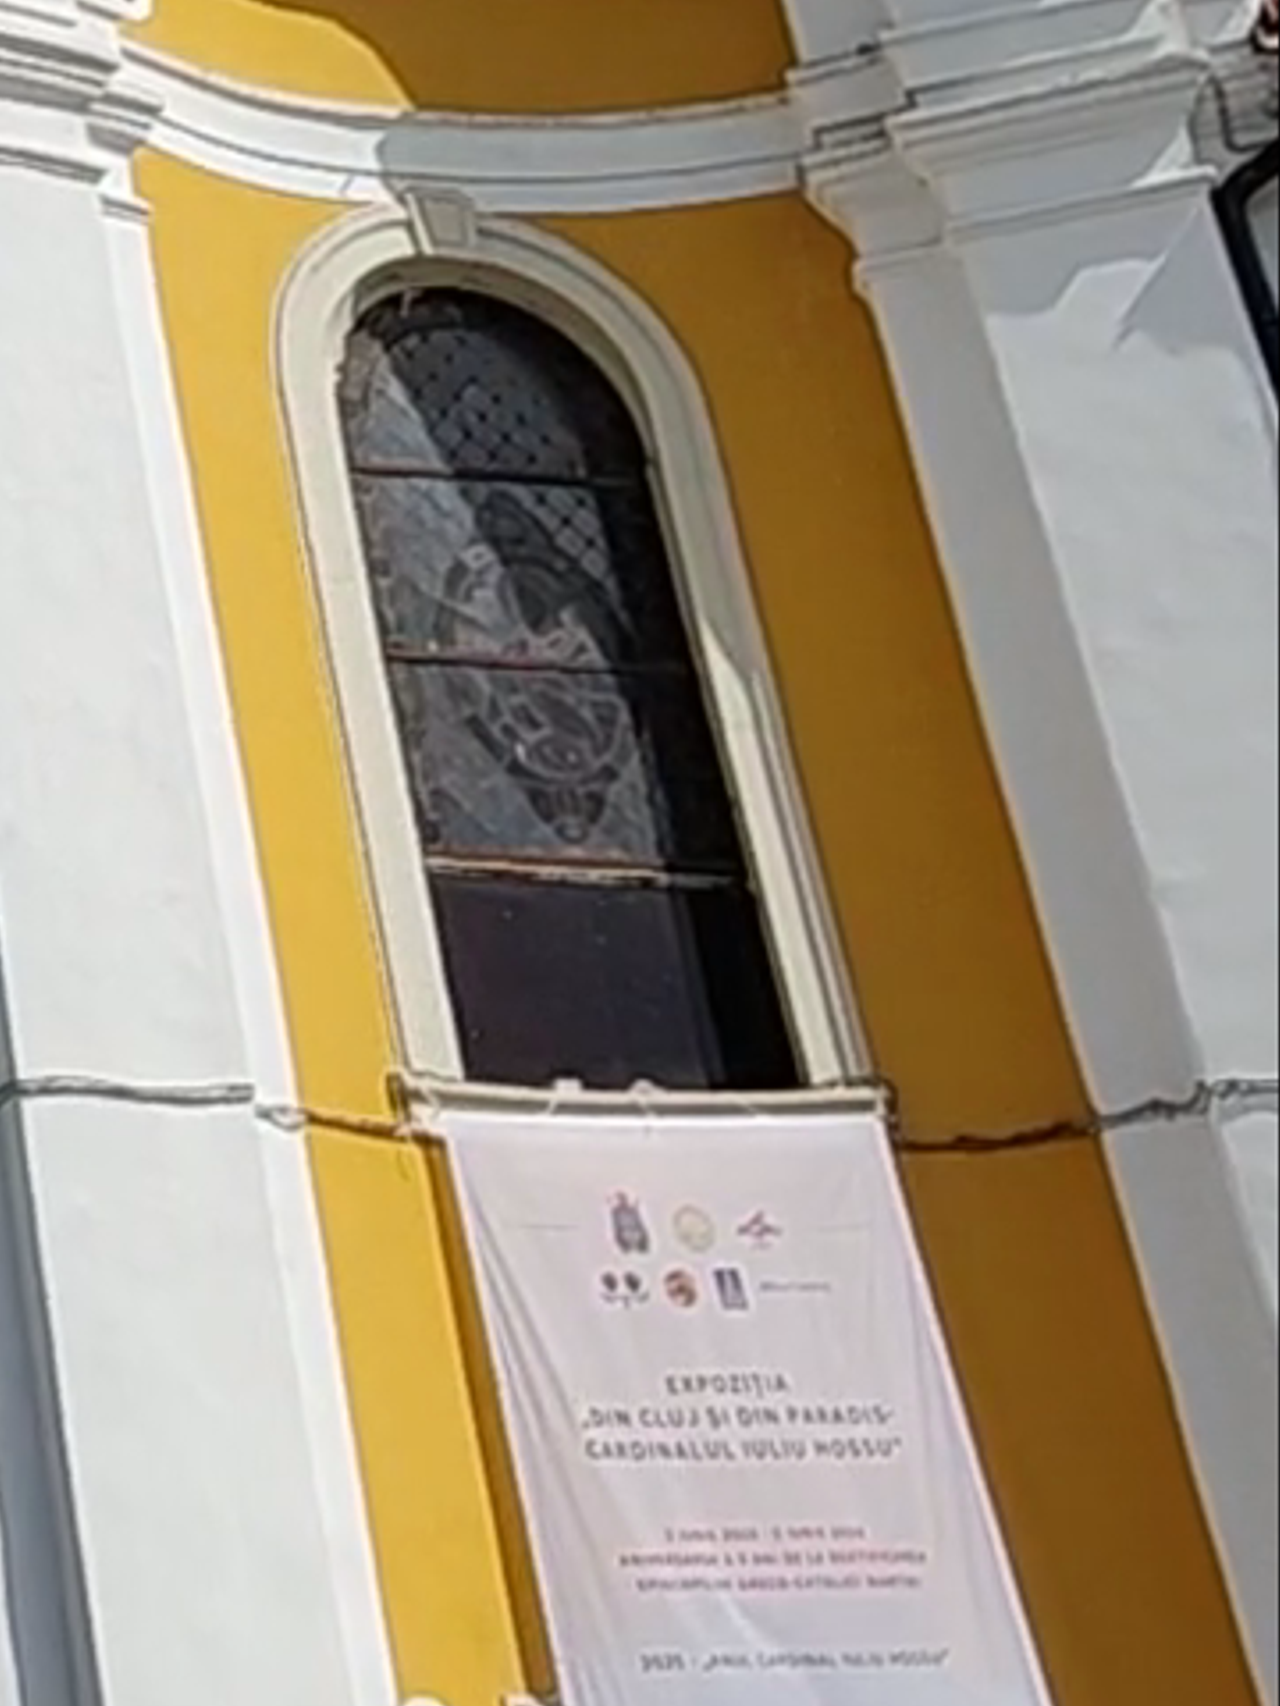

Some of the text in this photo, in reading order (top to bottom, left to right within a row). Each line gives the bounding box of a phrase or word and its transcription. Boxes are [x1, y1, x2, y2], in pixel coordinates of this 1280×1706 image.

[639, 1407, 699, 1429] CLUJ
[736, 1406, 780, 1426] DIN
[585, 1438, 736, 1462] CARDINALUL
[742, 1439, 807, 1460] IULIU
